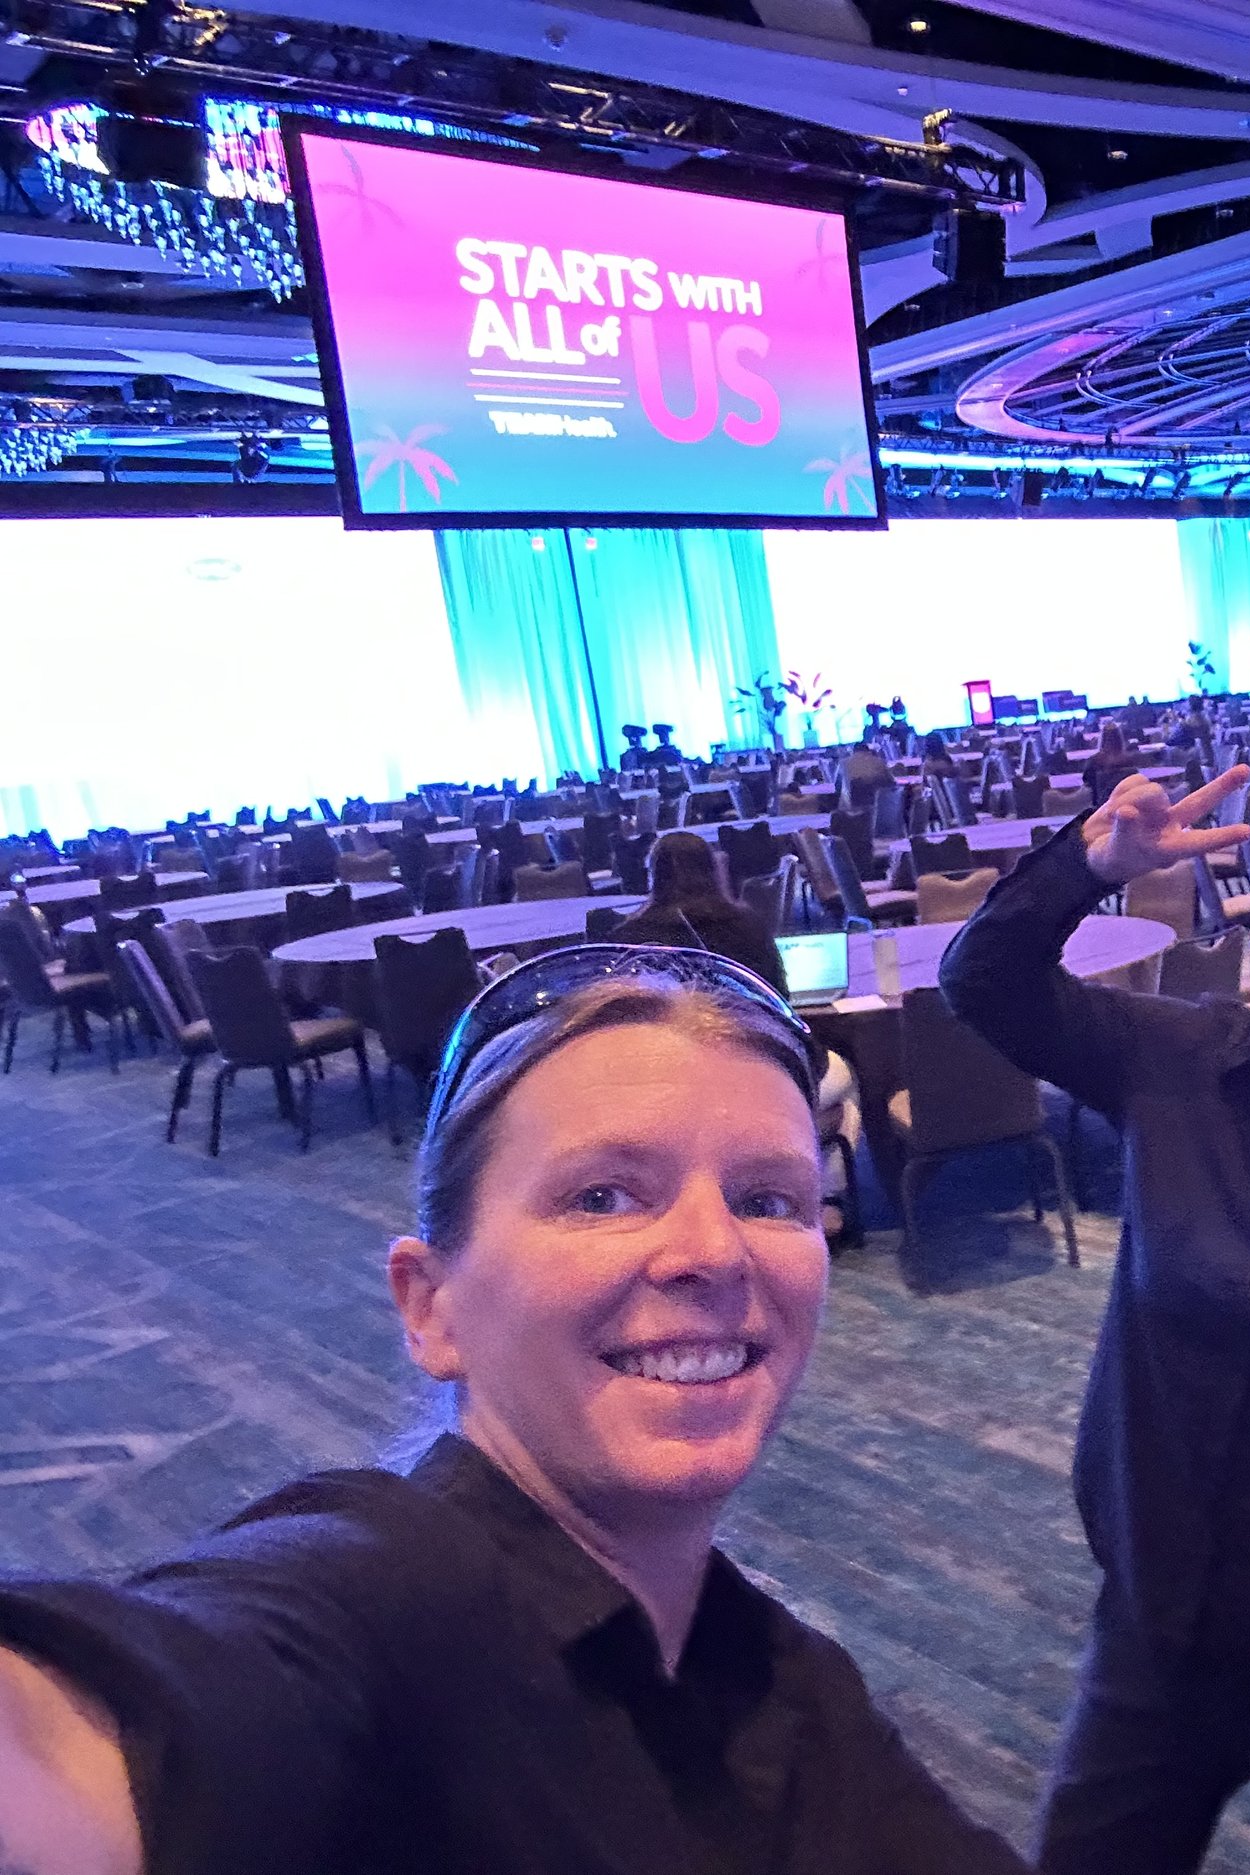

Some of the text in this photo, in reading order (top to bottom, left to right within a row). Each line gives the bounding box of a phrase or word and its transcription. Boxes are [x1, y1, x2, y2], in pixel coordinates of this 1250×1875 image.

[455, 237, 763, 316] STARTS WITH
[467, 298, 587, 366] ALL
[580, 315, 622, 357] of
[629, 314, 782, 447] US
